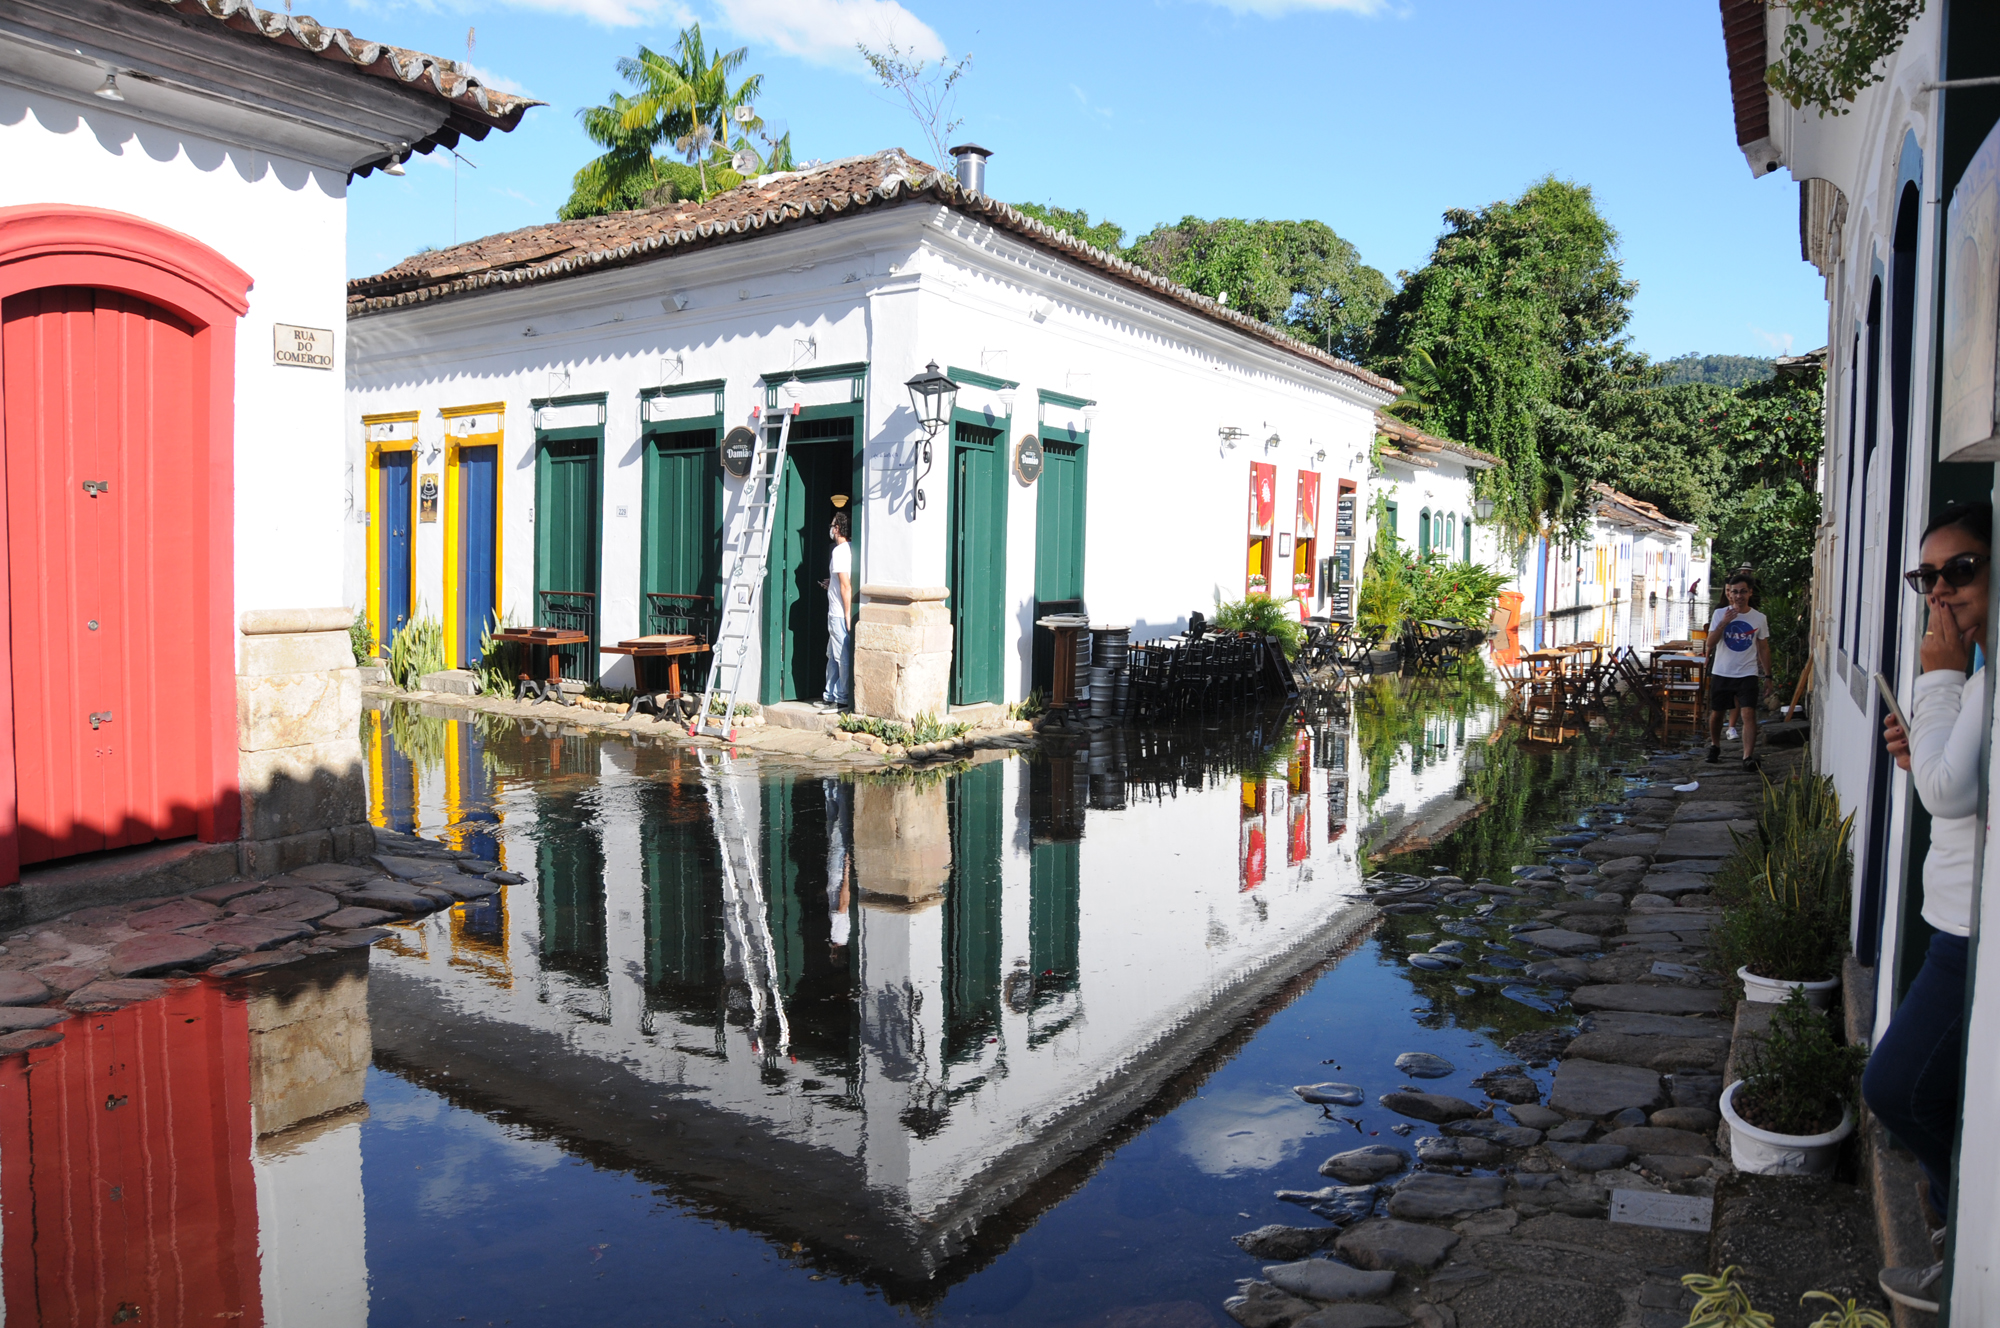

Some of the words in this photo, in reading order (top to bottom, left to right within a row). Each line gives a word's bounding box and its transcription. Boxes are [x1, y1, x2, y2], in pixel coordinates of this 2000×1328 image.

[294, 330, 315, 341] RUA
[297, 342, 313, 352] DO
[1725, 631, 1752, 641] NASA
